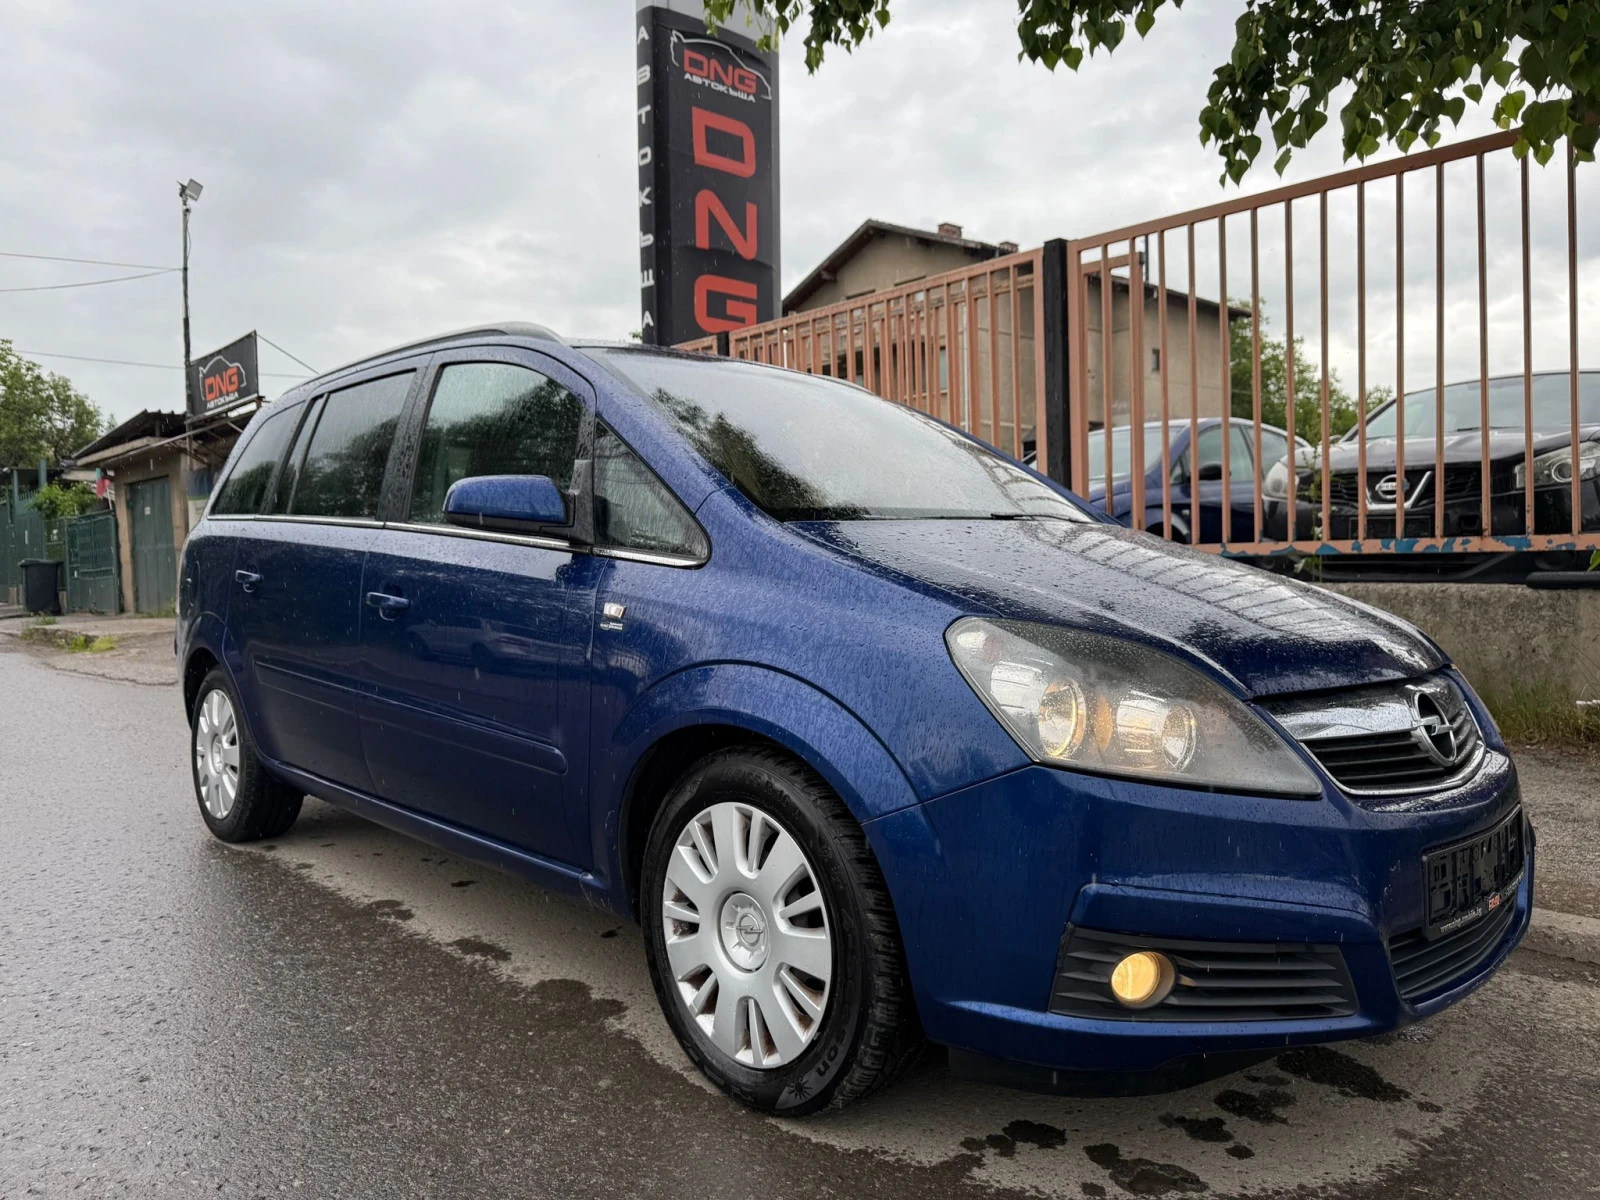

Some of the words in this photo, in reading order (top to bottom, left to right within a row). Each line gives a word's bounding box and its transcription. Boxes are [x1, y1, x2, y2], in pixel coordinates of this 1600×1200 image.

[683, 49, 757, 94] DNG
[692, 106, 757, 333] DNG
[204, 366, 239, 402] DNG
